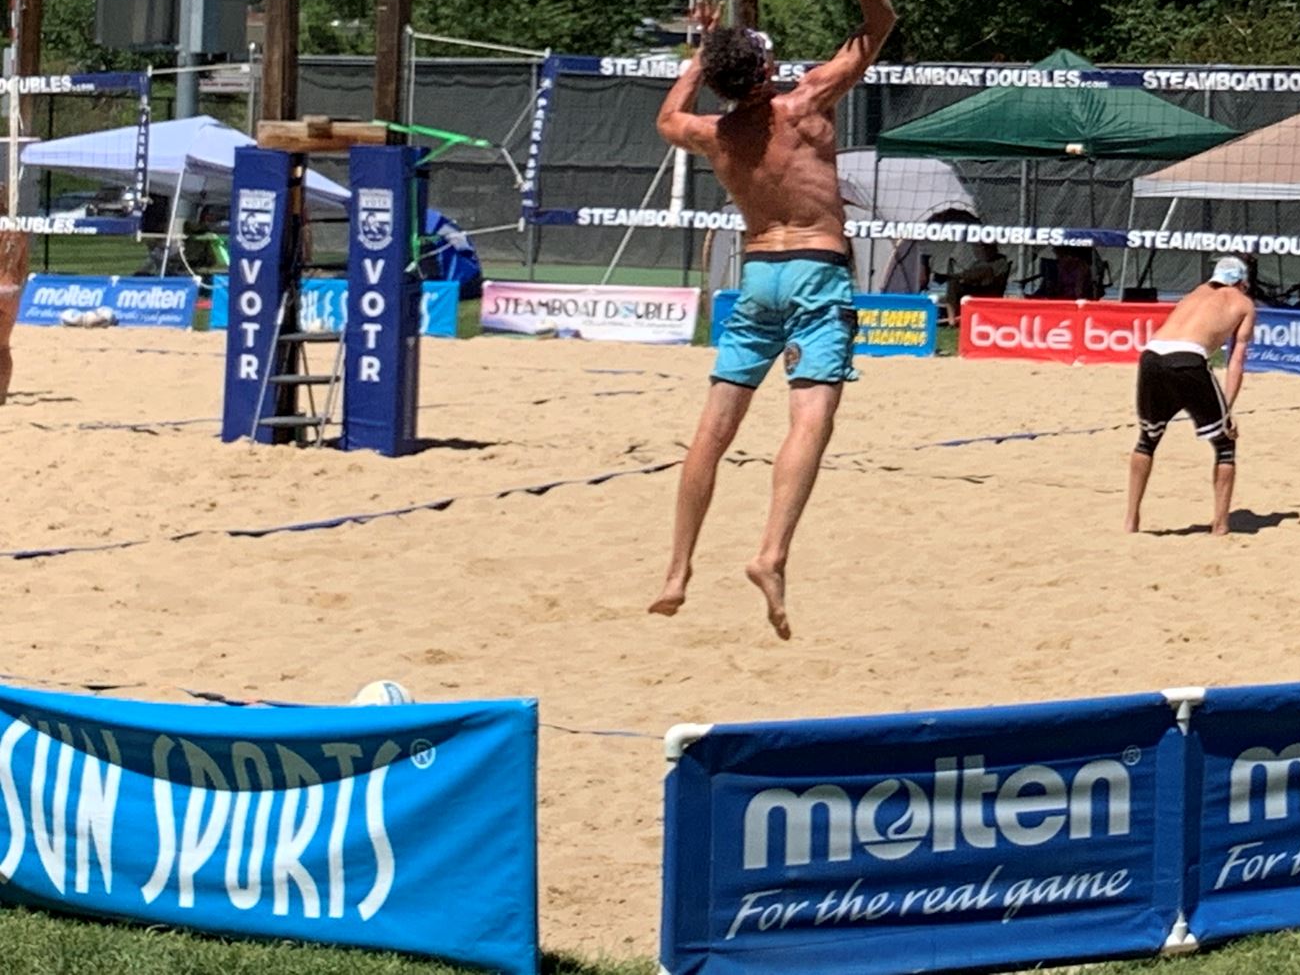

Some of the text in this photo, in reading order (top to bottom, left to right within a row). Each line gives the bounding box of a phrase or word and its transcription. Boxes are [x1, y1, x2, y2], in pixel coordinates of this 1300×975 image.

[600, 58, 691, 78] STEAMB
[864, 65, 984, 85] STEAMBOAT
[1143, 70, 1273, 91] STEAMBOAT
[578, 207, 747, 231] STEAMBOAT DOUB
[843, 220, 966, 242] STEAMBOAT
[1127, 230, 1259, 253] STEAMBOAT
[33, 285, 105, 307] molten
[117, 288, 189, 309] molten
[489, 296, 687, 322] STEAMBOAT DOUBLES
[240, 259, 263, 381] VOTR
[360, 258, 386, 383] VOTR
[970, 312, 1073, 349] bollé
[1084, 316, 1156, 352] boll
[743, 755, 1131, 870] molten
[141, 735, 402, 921] SPORTS
[1215, 841, 1278, 890] For
[726, 866, 1131, 939] For the real game
